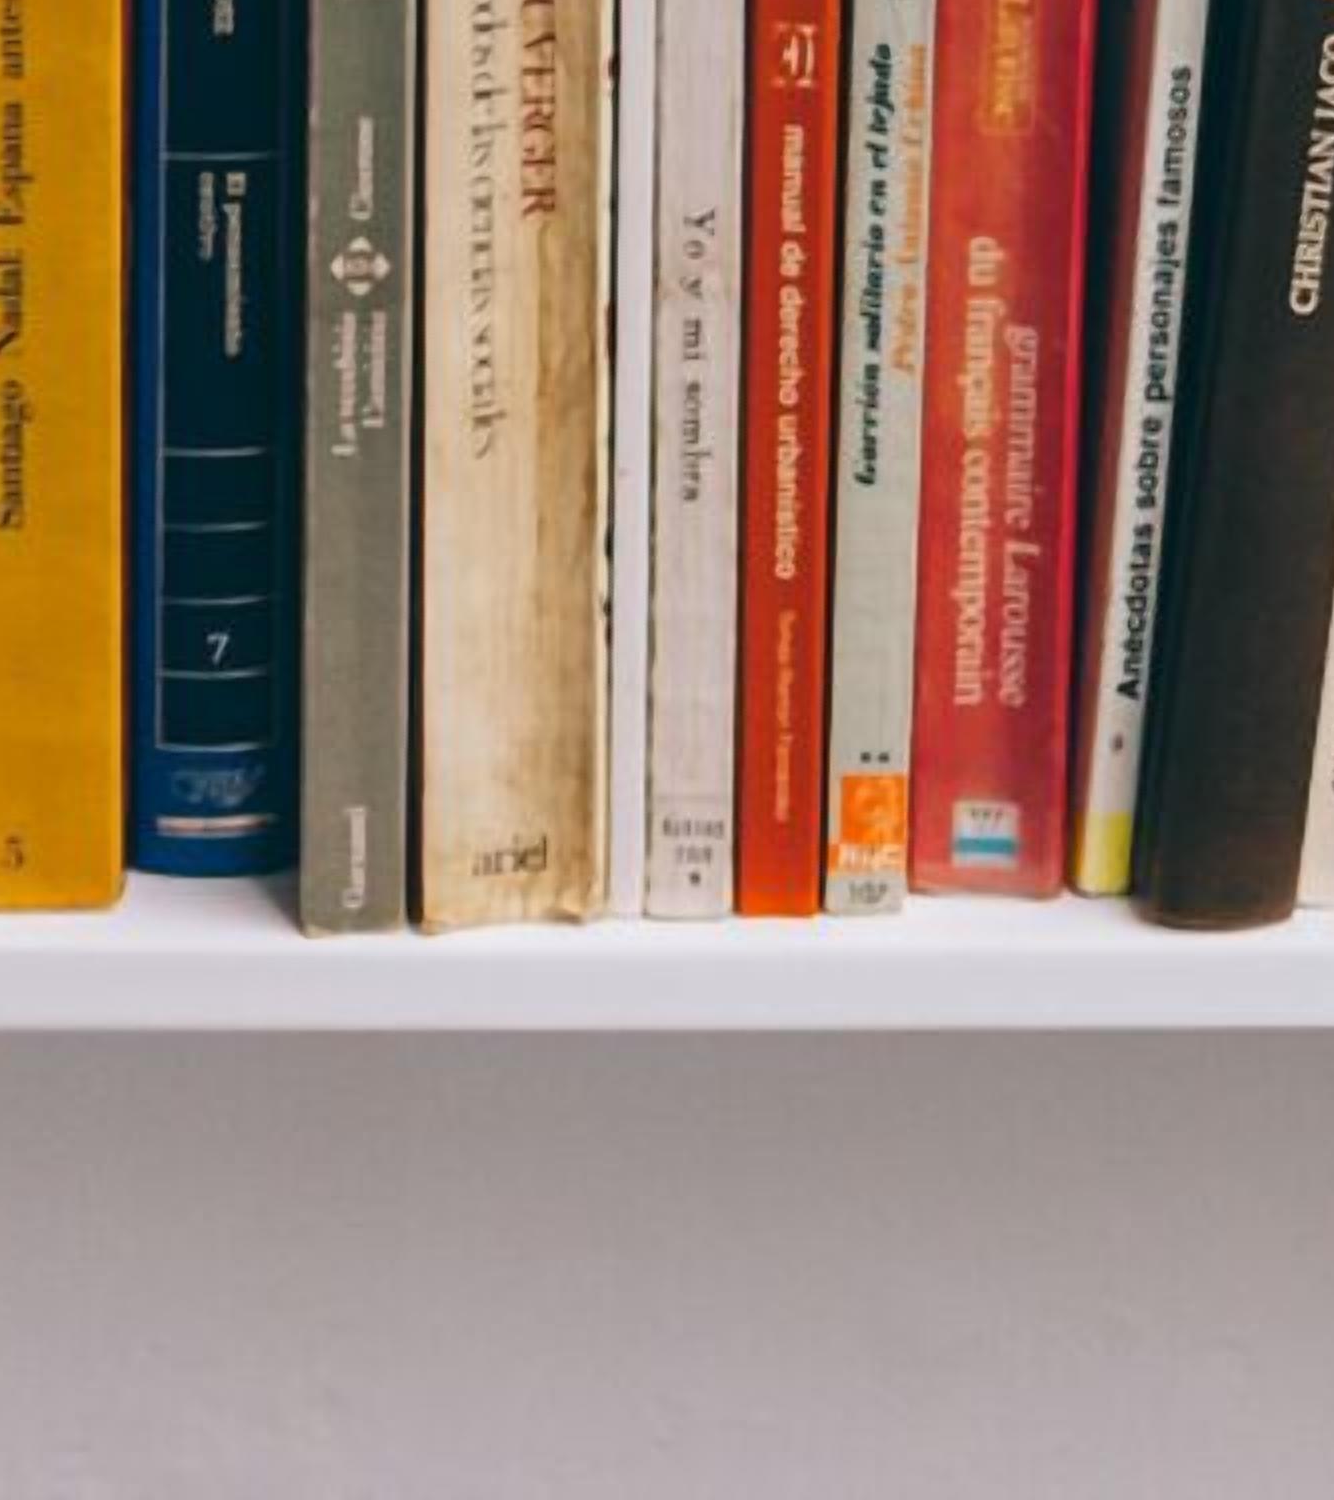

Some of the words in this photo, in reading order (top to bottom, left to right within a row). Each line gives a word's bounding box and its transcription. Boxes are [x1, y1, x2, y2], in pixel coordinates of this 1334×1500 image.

[782, 125, 806, 232] manual
[865, 142, 888, 170] el
[1157, 66, 1192, 206] famosos
[684, 209, 715, 259] Yo
[869, 180, 886, 216] en
[679, 276, 702, 299] y
[780, 241, 805, 277] de
[683, 318, 704, 361] mi
[779, 286, 804, 406] derecho
[1145, 221, 1191, 406] personajes
[681, 380, 711, 502] sombra
[998, 322, 1037, 528] grammaire
[1137, 417, 1163, 509] sobre
[207, 633, 229, 663] 7
[996, 539, 1040, 707] Larousse
